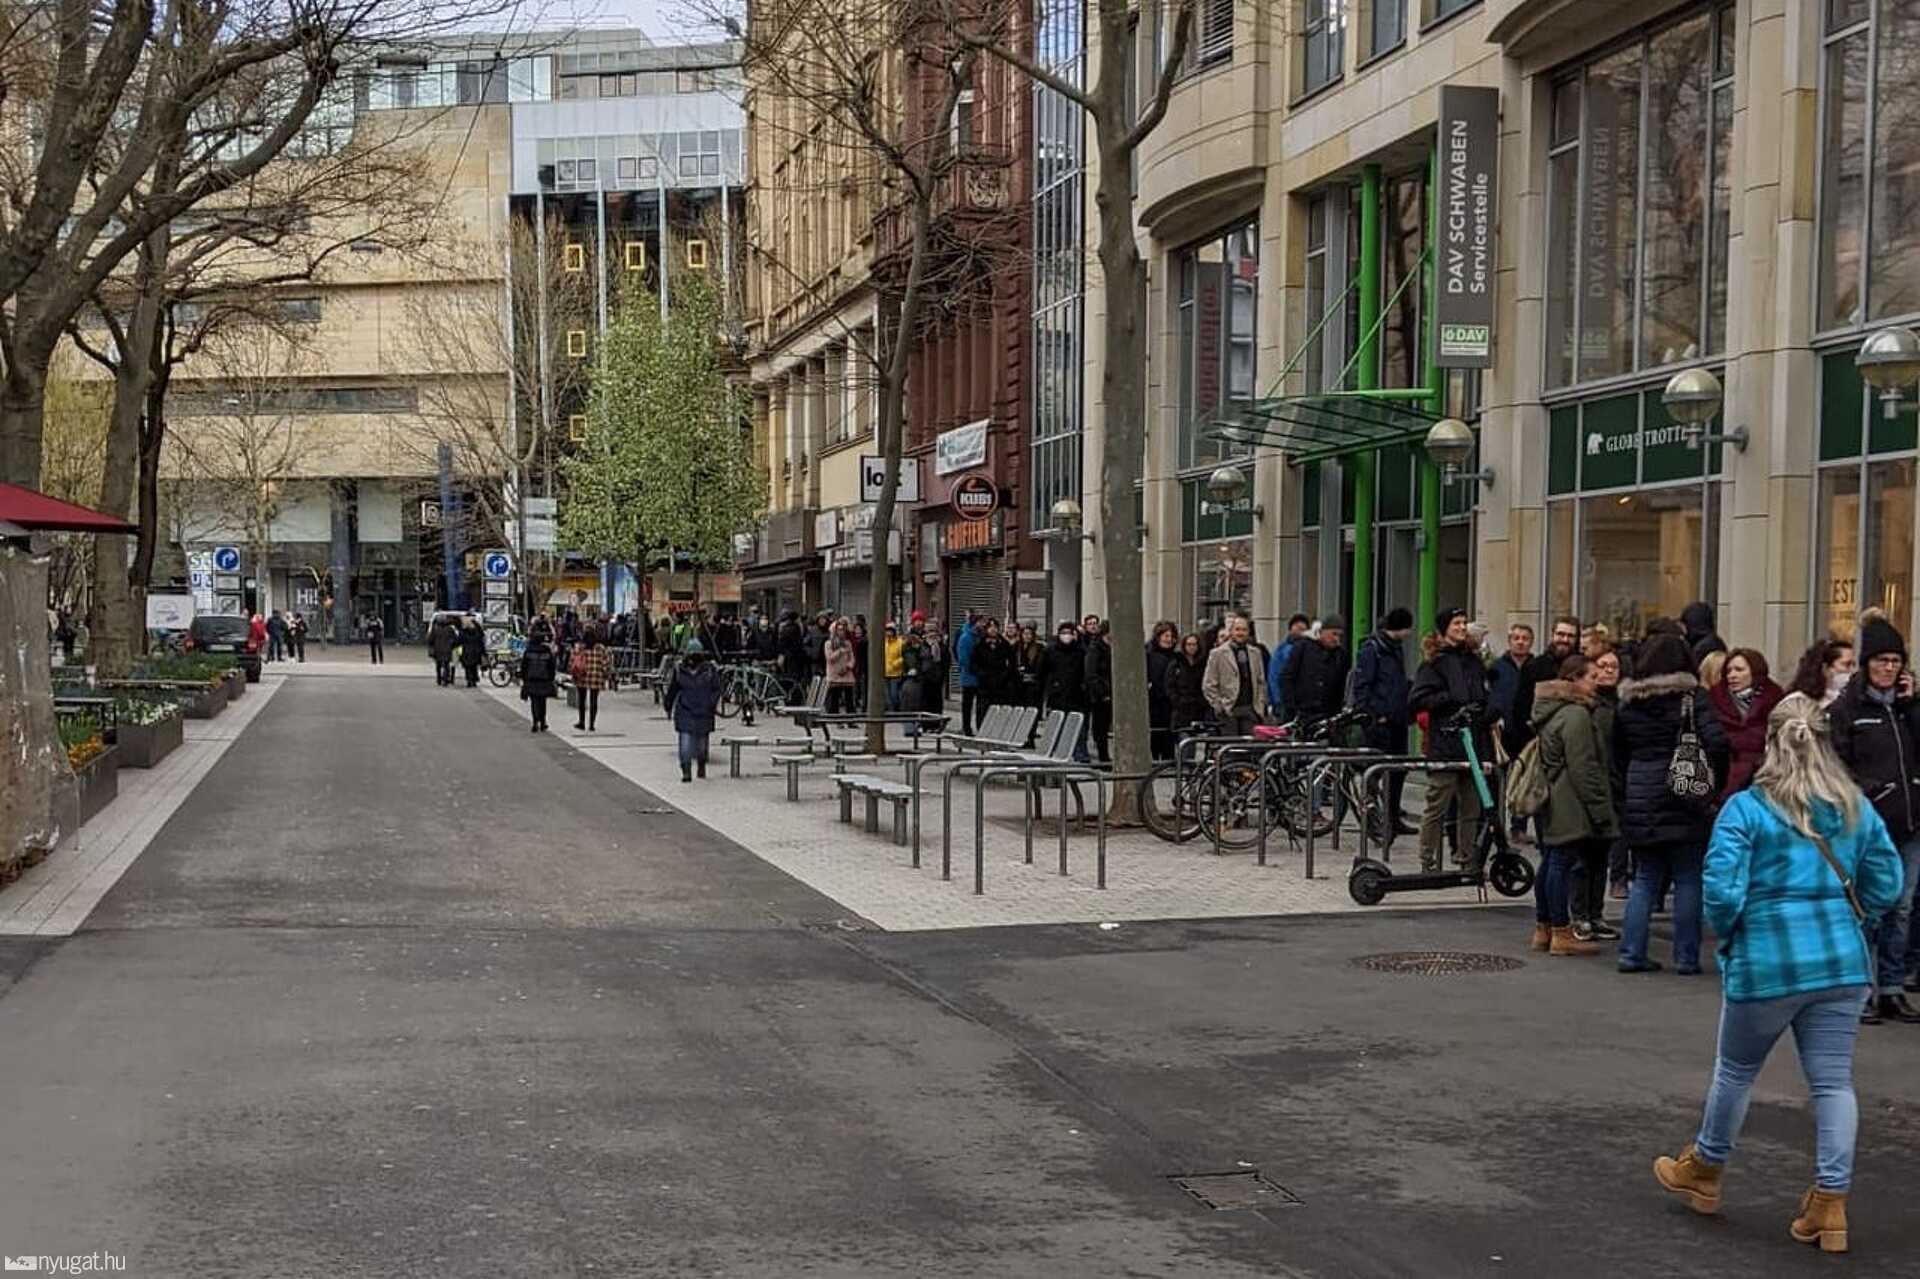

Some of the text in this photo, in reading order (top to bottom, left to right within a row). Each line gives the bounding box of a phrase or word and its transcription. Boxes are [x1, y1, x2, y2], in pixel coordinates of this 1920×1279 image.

[1447, 120, 1468, 293] DAV SCHWABEN
[1470, 173, 1488, 293] Servicestelle
[1456, 328, 1486, 341] DAV
[1606, 425, 1692, 452] GLOBETROTTE
